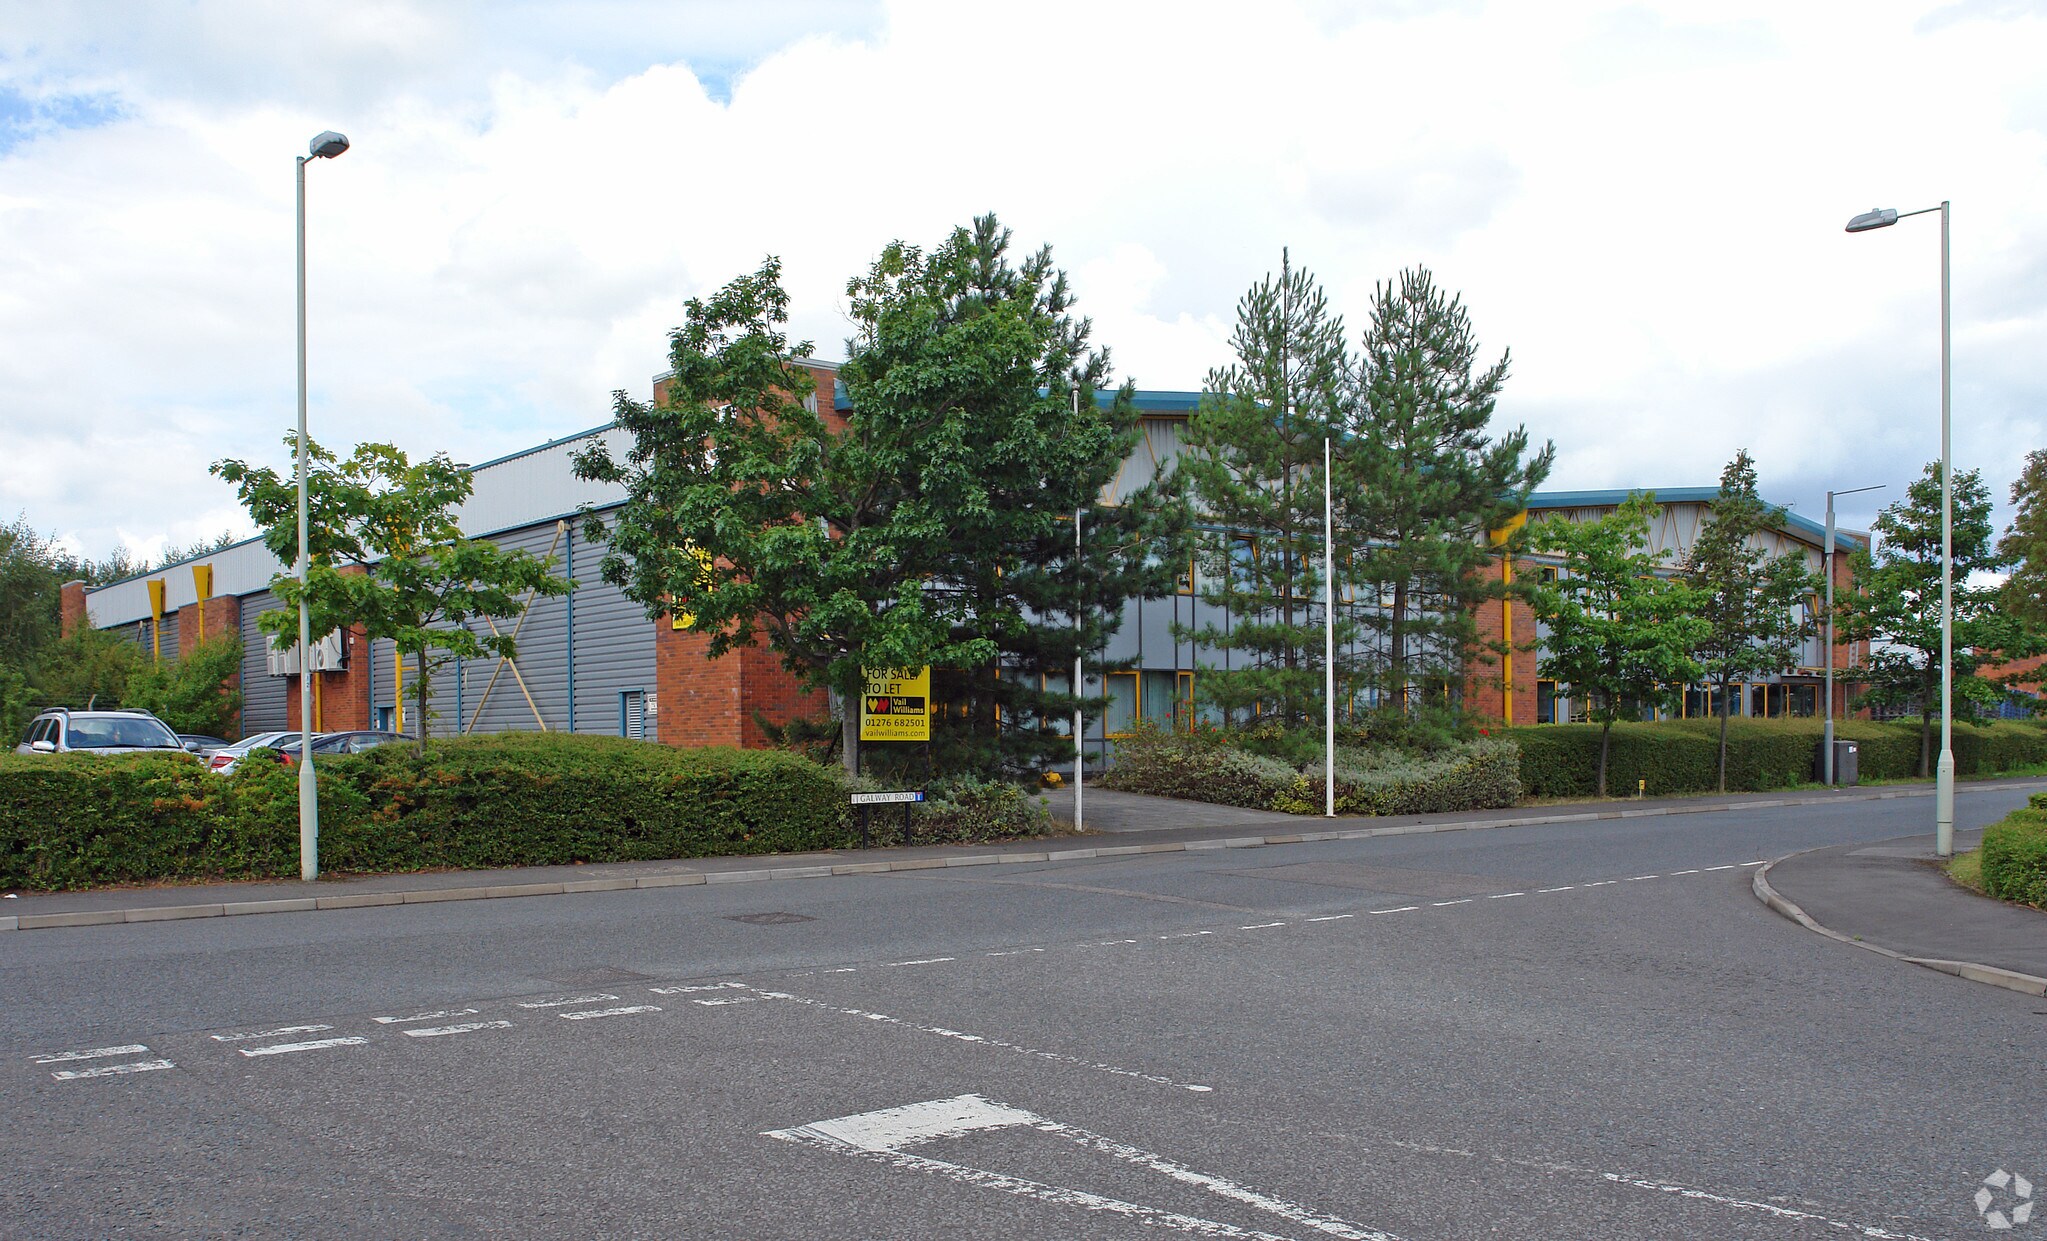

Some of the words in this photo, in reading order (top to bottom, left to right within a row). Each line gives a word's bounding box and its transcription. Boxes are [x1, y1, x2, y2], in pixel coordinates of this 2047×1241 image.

[867, 668, 888, 680] FOR
[867, 683, 881, 694] TO
[884, 683, 902, 694] LET
[893, 698, 907, 706] Vail
[893, 706, 924, 714] Williams
[865, 729, 926, 737] vailwilliams.com
[860, 794, 891, 802] GALWAY
[894, 793, 915, 801] ROAD
